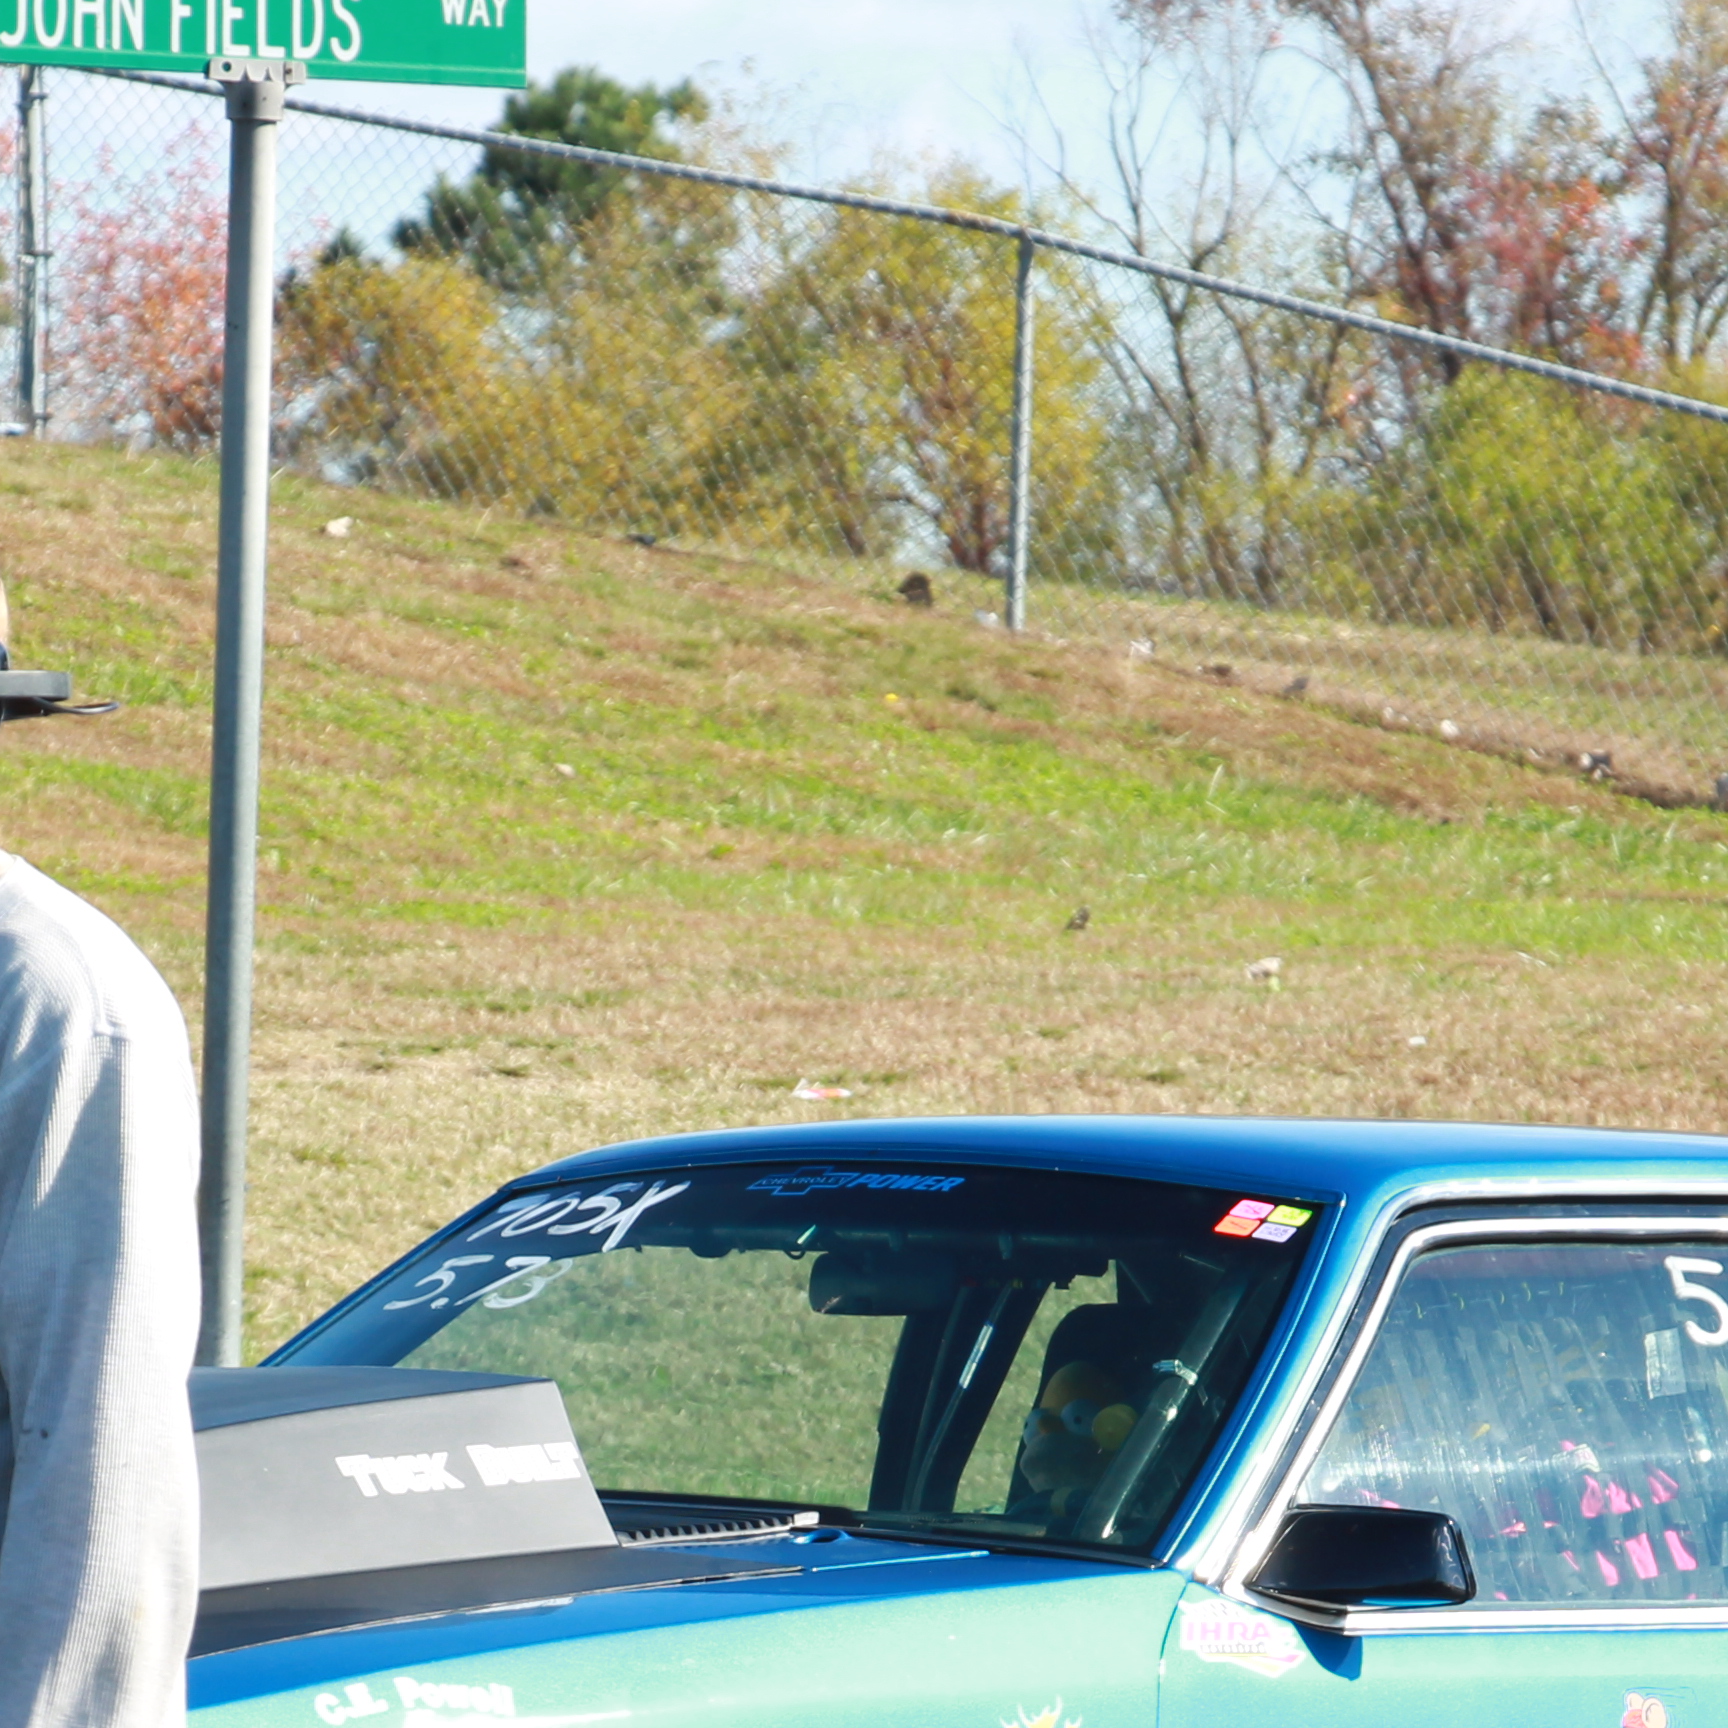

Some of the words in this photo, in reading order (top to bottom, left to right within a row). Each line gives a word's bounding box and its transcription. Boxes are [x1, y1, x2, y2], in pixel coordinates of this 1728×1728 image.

[171, 0, 363, 61] FIELDS
[441, 0, 506, 27] WAY
[846, 1173, 966, 1192] POWER
[467, 1180, 691, 1254] 705X
[1186, 1621, 1271, 1641] IHRA
